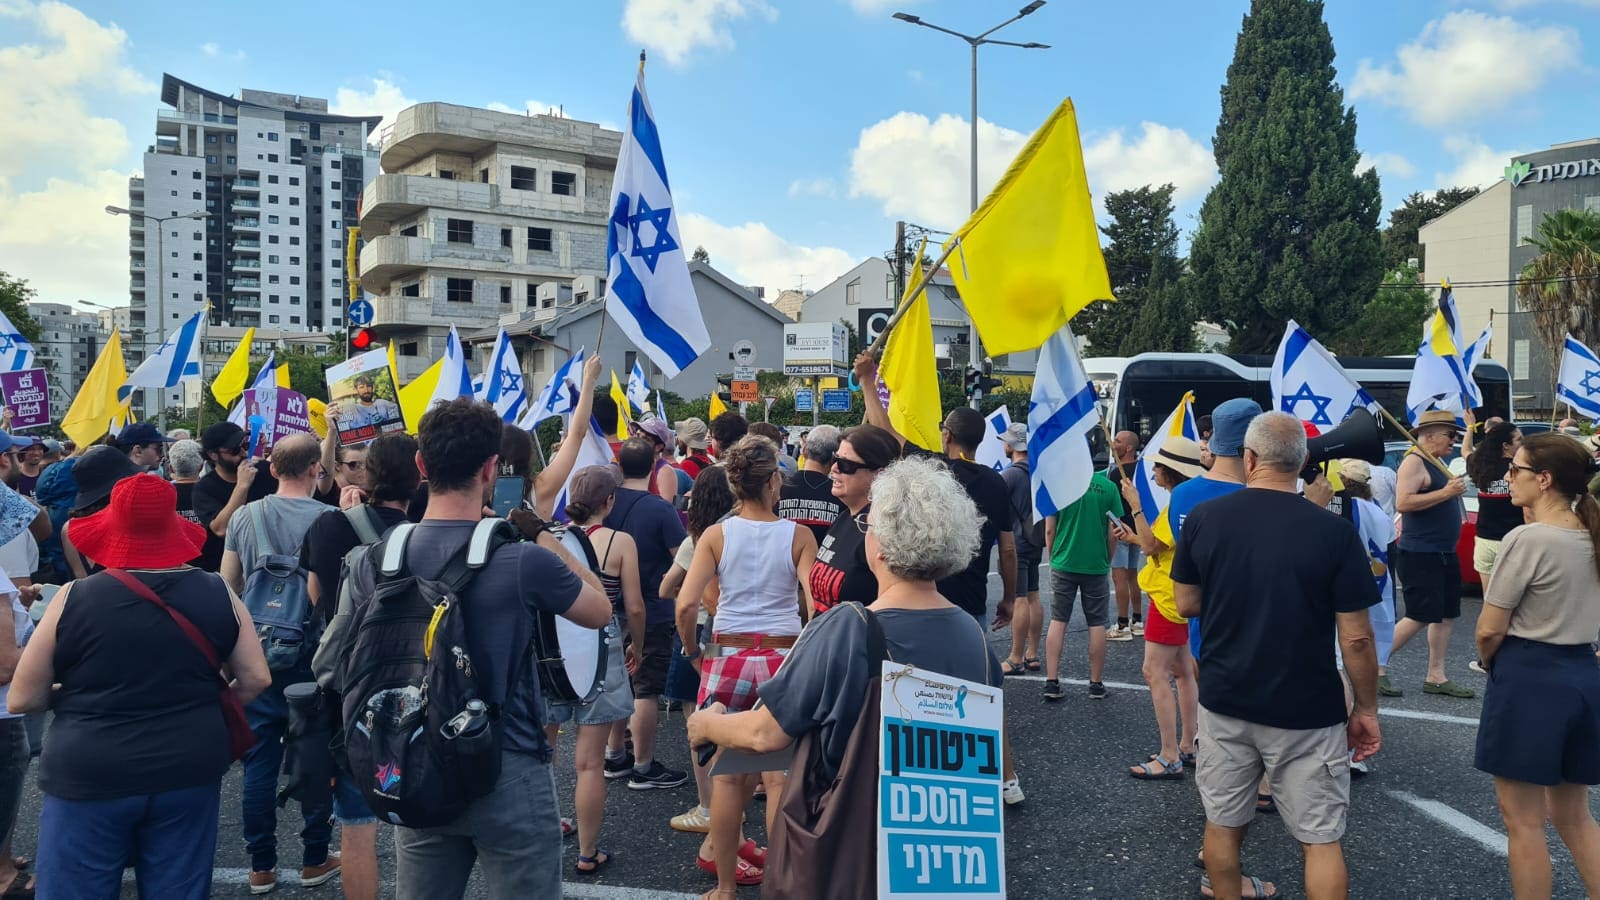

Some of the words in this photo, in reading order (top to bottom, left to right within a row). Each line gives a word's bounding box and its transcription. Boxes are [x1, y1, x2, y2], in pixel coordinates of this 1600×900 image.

[287, 396, 302, 414] לא
[278, 412, 309, 428] למלחמת
[939, 701, 954, 710] שלום
[888, 723, 998, 776] ביטחון
[890, 783, 968, 826] הסכם
[902, 844, 987, 884] מדיני
